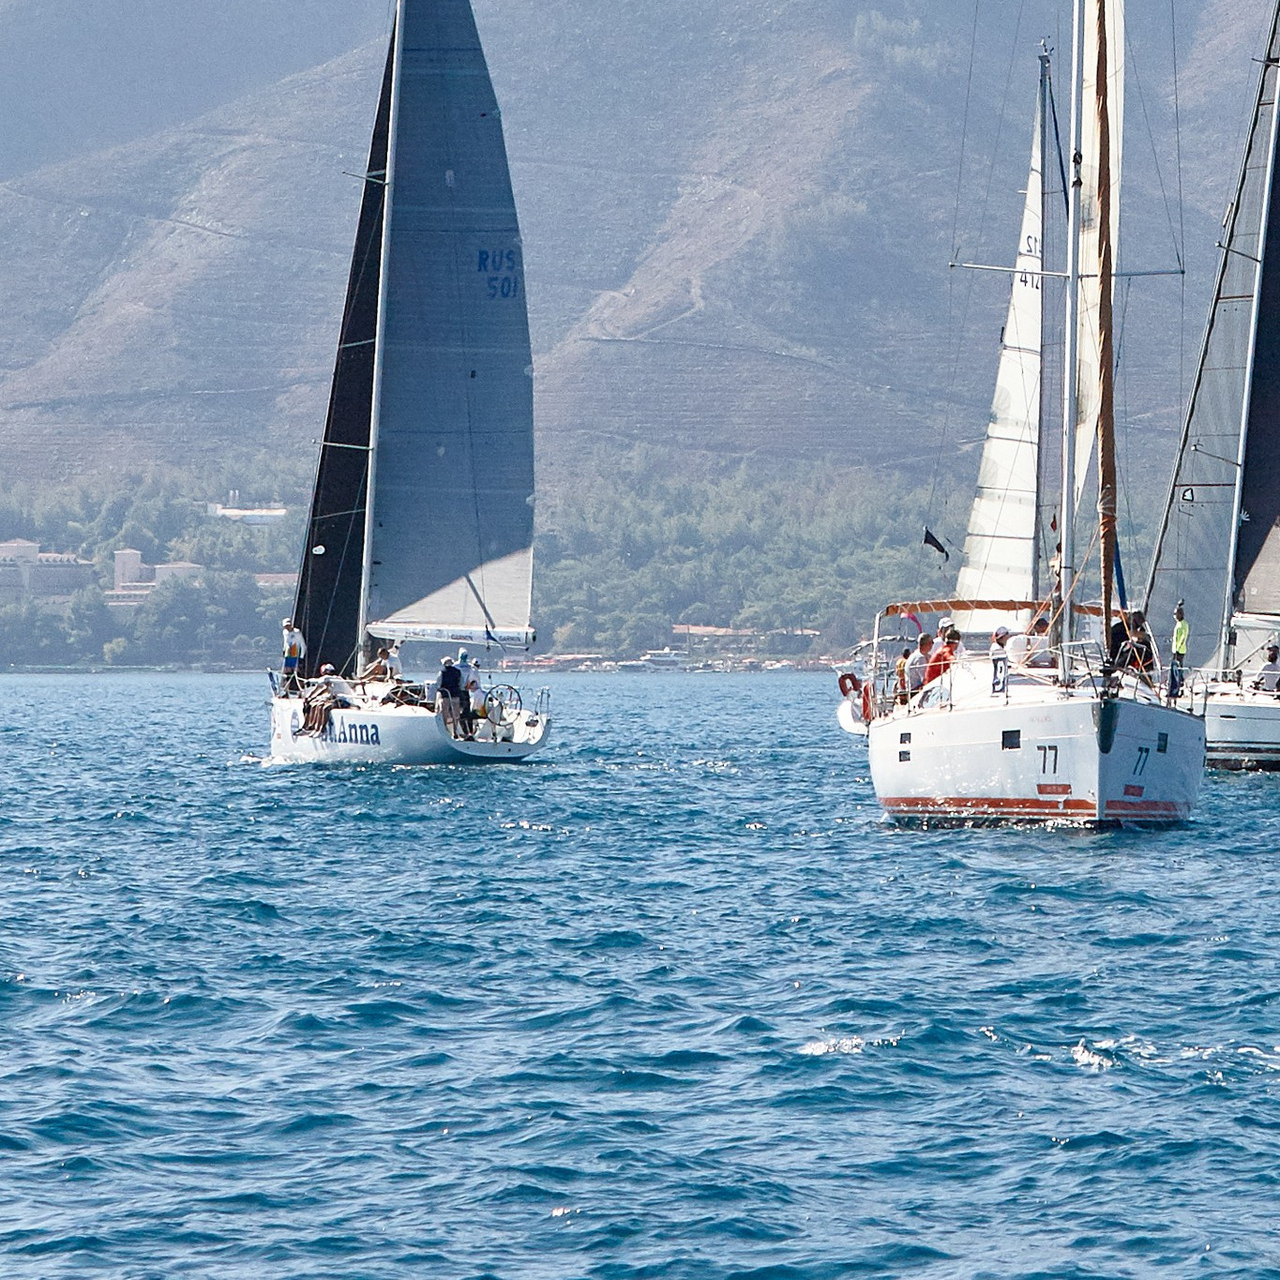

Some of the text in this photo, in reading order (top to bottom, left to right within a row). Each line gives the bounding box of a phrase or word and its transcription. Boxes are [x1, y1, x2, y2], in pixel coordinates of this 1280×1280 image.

[478, 250, 515, 272] RUS
[487, 276, 518, 299] 501
[1037, 745, 1058, 774] 77
[1133, 746, 1150, 776] 77
